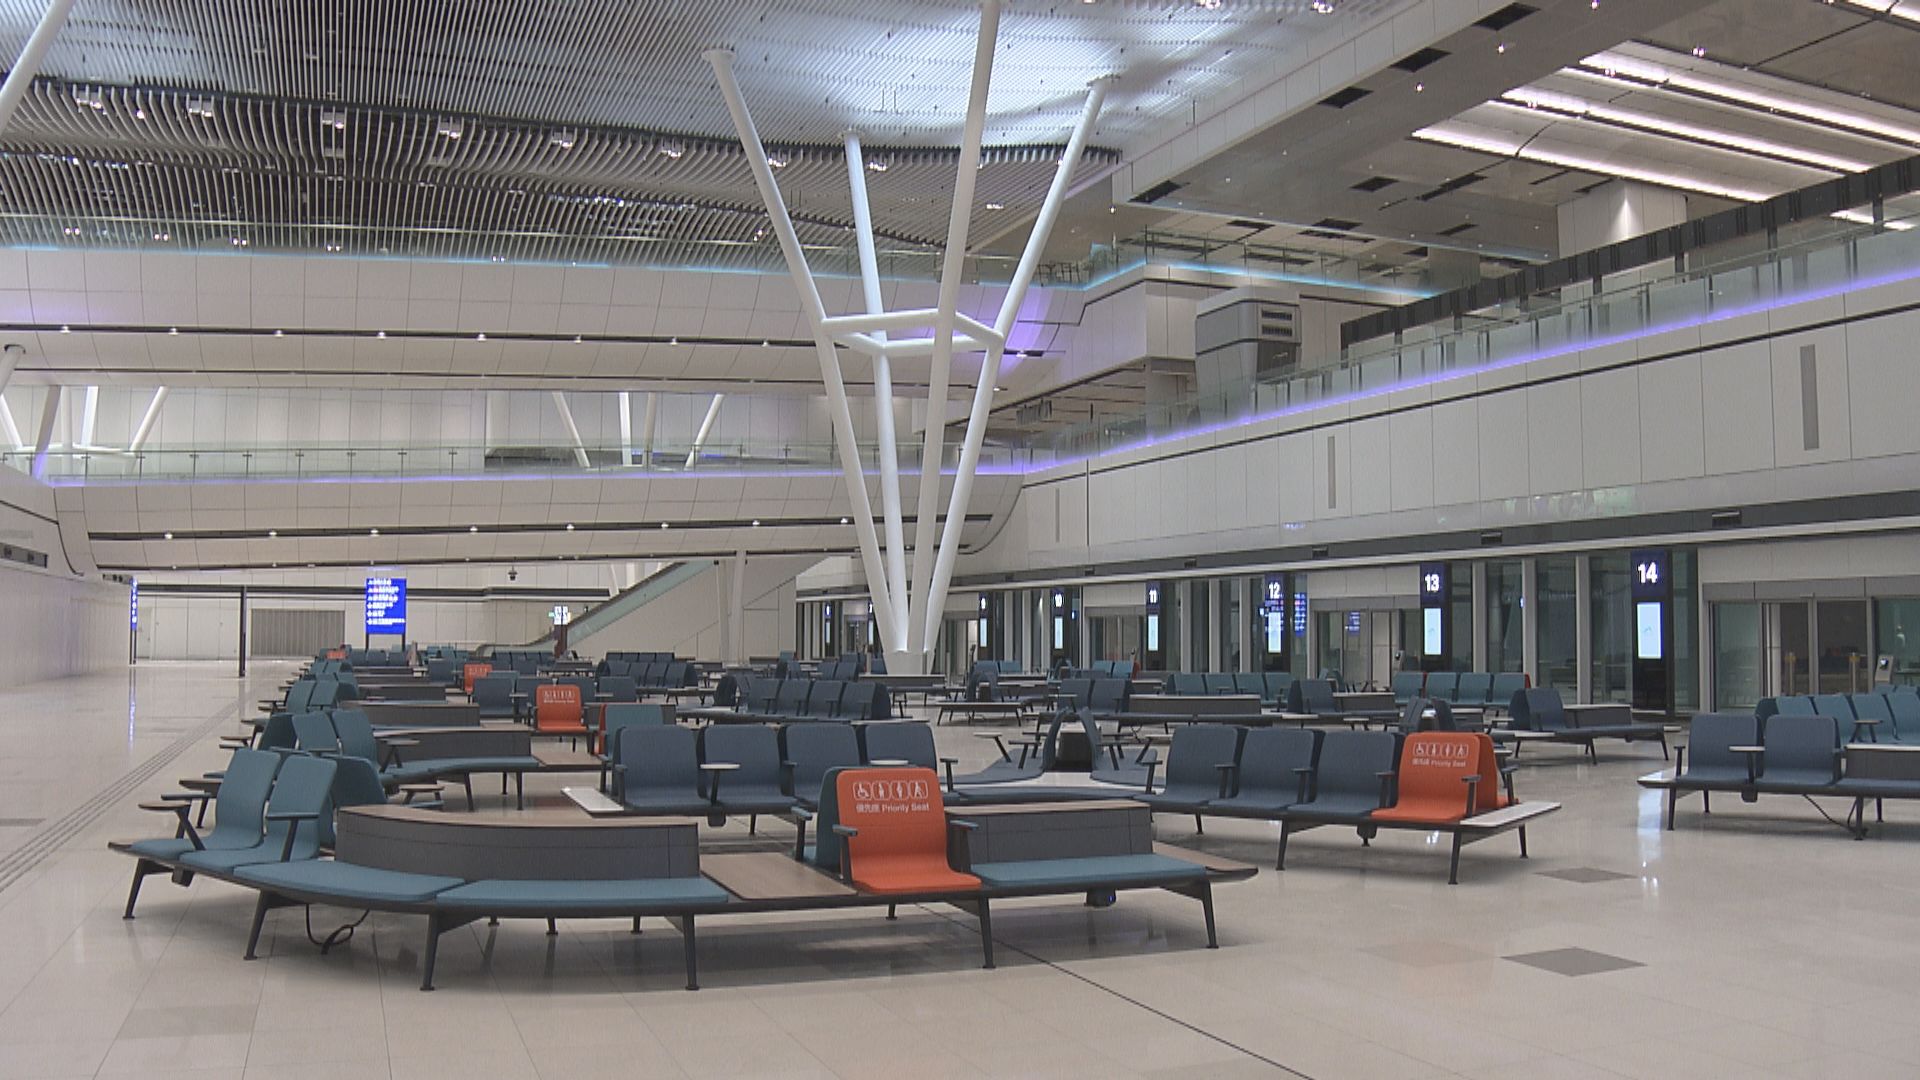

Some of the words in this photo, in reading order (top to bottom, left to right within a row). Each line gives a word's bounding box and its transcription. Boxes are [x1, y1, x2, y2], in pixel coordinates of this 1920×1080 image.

[1637, 562, 1658, 584] 14
[1424, 573, 1440, 592] 13
[1149, 590, 1158, 603] 11
[1268, 582, 1281, 599] 12
[1054, 594, 1062, 607] 10
[881, 802, 909, 813] Priority
[911, 802, 929, 811] Seat
